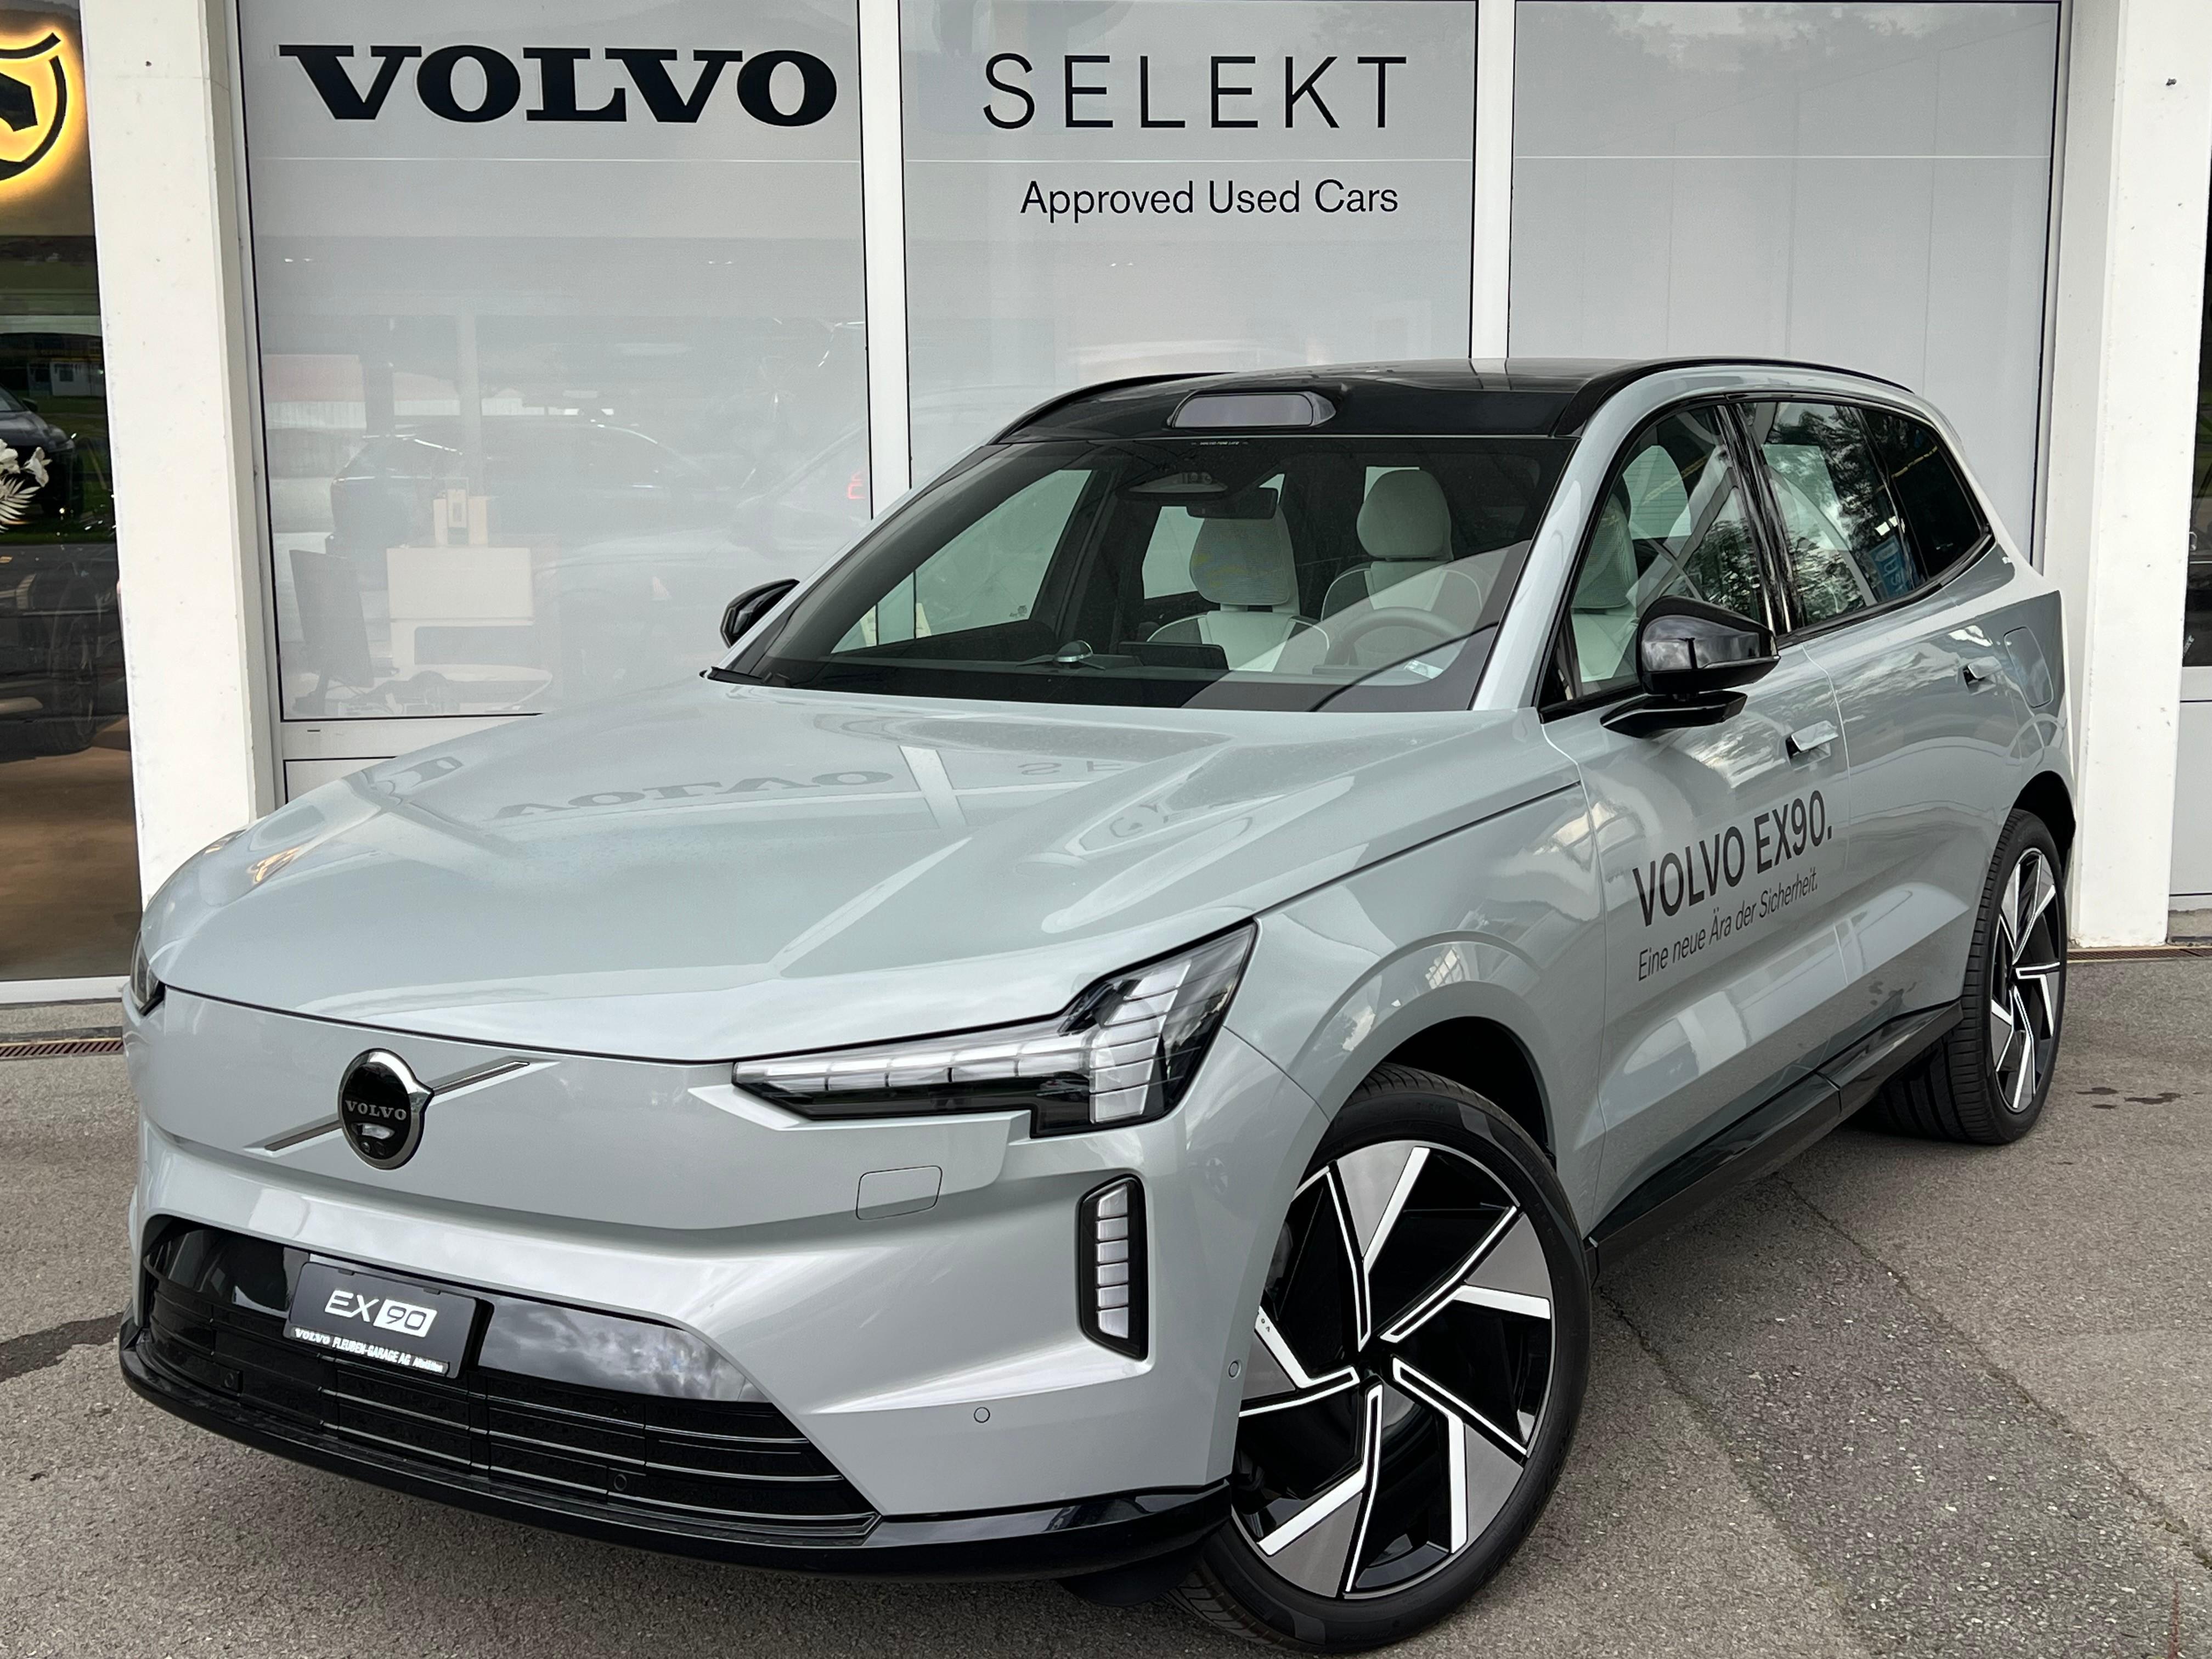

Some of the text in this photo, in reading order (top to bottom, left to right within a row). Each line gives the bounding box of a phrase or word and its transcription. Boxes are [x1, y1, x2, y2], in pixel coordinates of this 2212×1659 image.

[279, 45, 837, 126] VOLVO
[983, 53, 1406, 129] SELEKT
[1020, 179, 1398, 223] Approved Used Cars
[1633, 790, 1832, 927] VOLVO EX90.
[1638, 867, 1818, 981] Eine neue Ära der Sicherheit.
[345, 1099, 407, 1121] VOLVO
[295, 1327, 330, 1345] VOLVO
[324, 1289, 428, 1331] EX90
